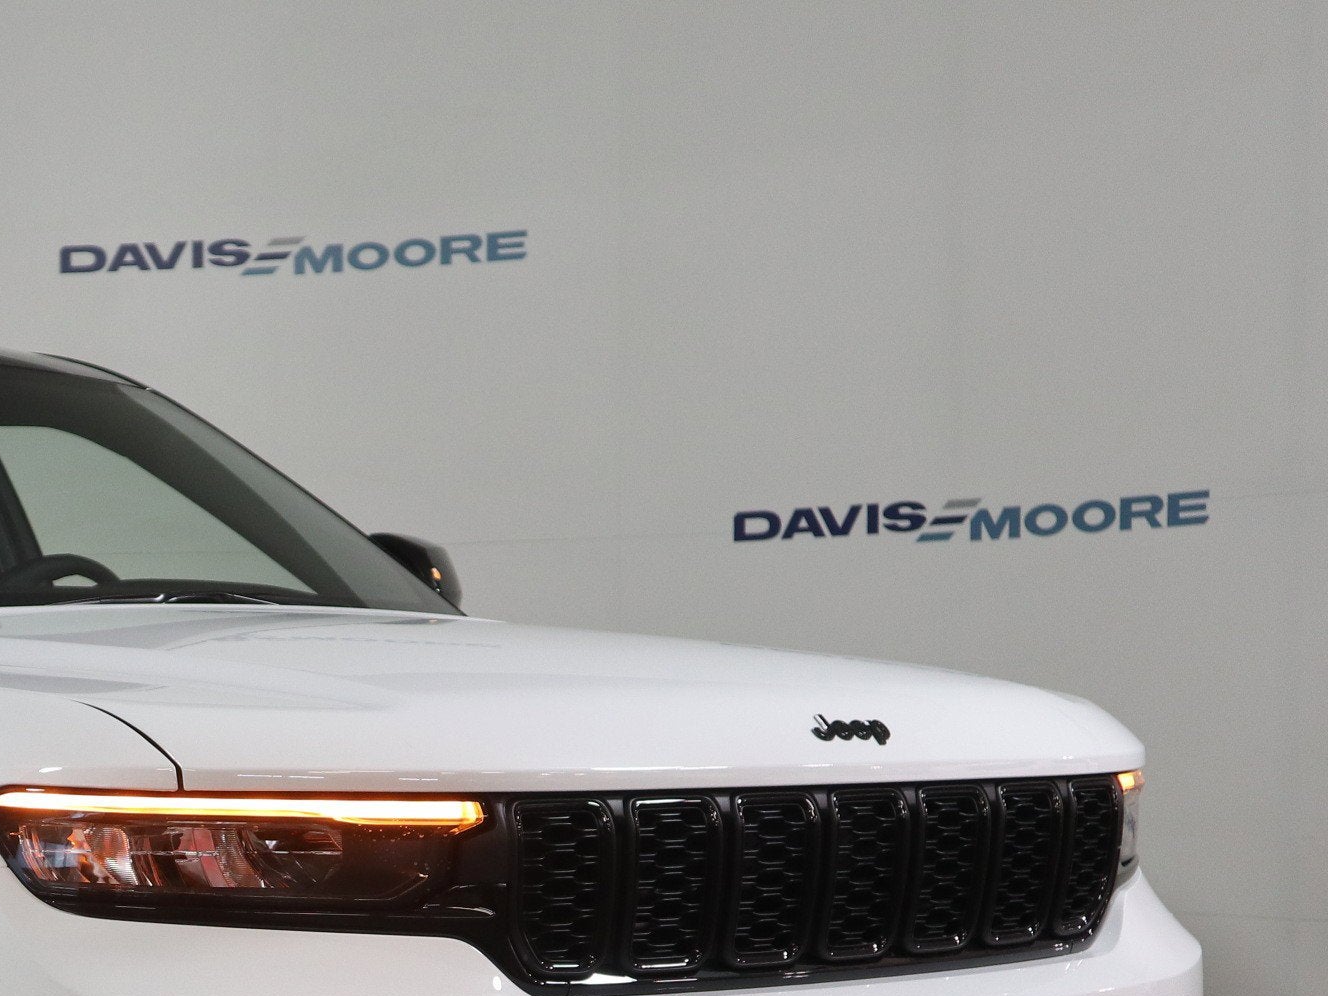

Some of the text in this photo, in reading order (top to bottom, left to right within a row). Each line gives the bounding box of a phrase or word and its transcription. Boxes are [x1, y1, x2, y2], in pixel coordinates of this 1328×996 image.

[59, 230, 528, 276] DAVIS MOORE
[733, 489, 1211, 542] DAVIS MOORE
[812, 713, 891, 746] Jeep
